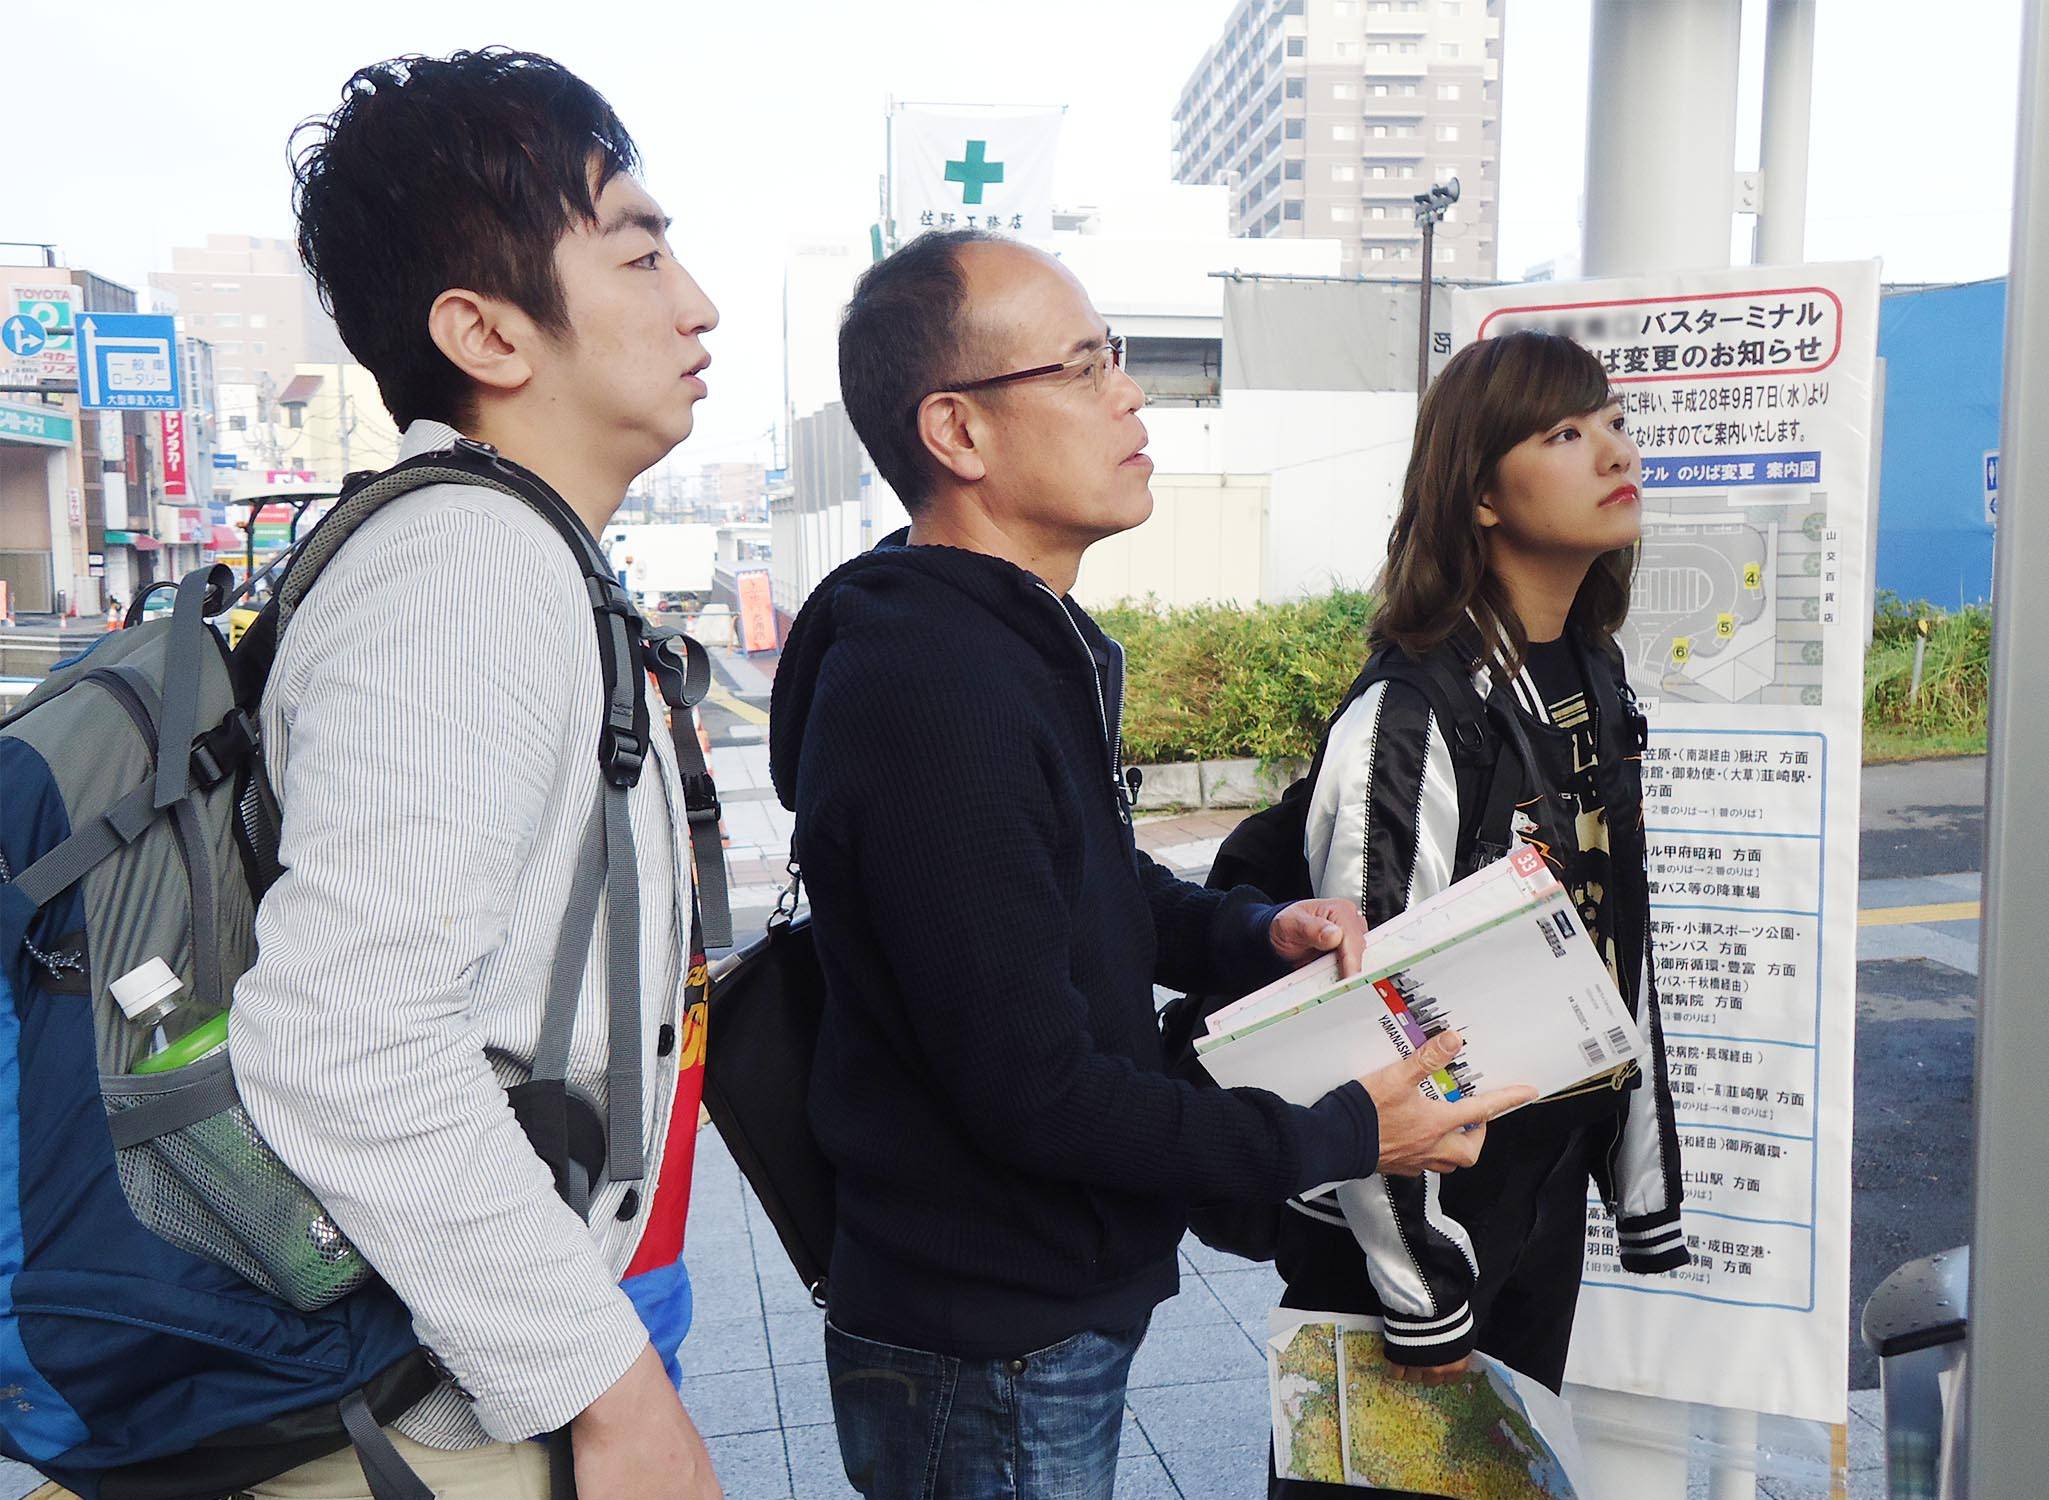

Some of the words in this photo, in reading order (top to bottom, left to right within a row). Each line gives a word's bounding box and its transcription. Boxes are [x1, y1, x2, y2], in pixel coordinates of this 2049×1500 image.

[15, 288, 71, 300] TOYOTA
[1641, 301, 1824, 336] バスターミナル
[111, 373, 168, 386] ロータリー
[1677, 459, 1755, 481] のりば変更
[1766, 458, 1816, 480] 案内図
[1823, 531, 1837, 623] 山交百貨店
[1779, 751, 1809, 765] 方面
[1645, 784, 1672, 798] 方面
[1732, 848, 1762, 862] 方面
[1719, 942, 1747, 956] 方面
[1767, 963, 1796, 977] 方面
[1660, 993, 1704, 1007] 属病院
[1715, 995, 1744, 1010] 方面
[1669, 1062, 1698, 1077] 方面
[1776, 1090, 1805, 1107] 方面
[1733, 1175, 1761, 1193] 方面
[1586, 1225, 1615, 1240] 新宿
[1723, 1259, 1752, 1276] 方面
